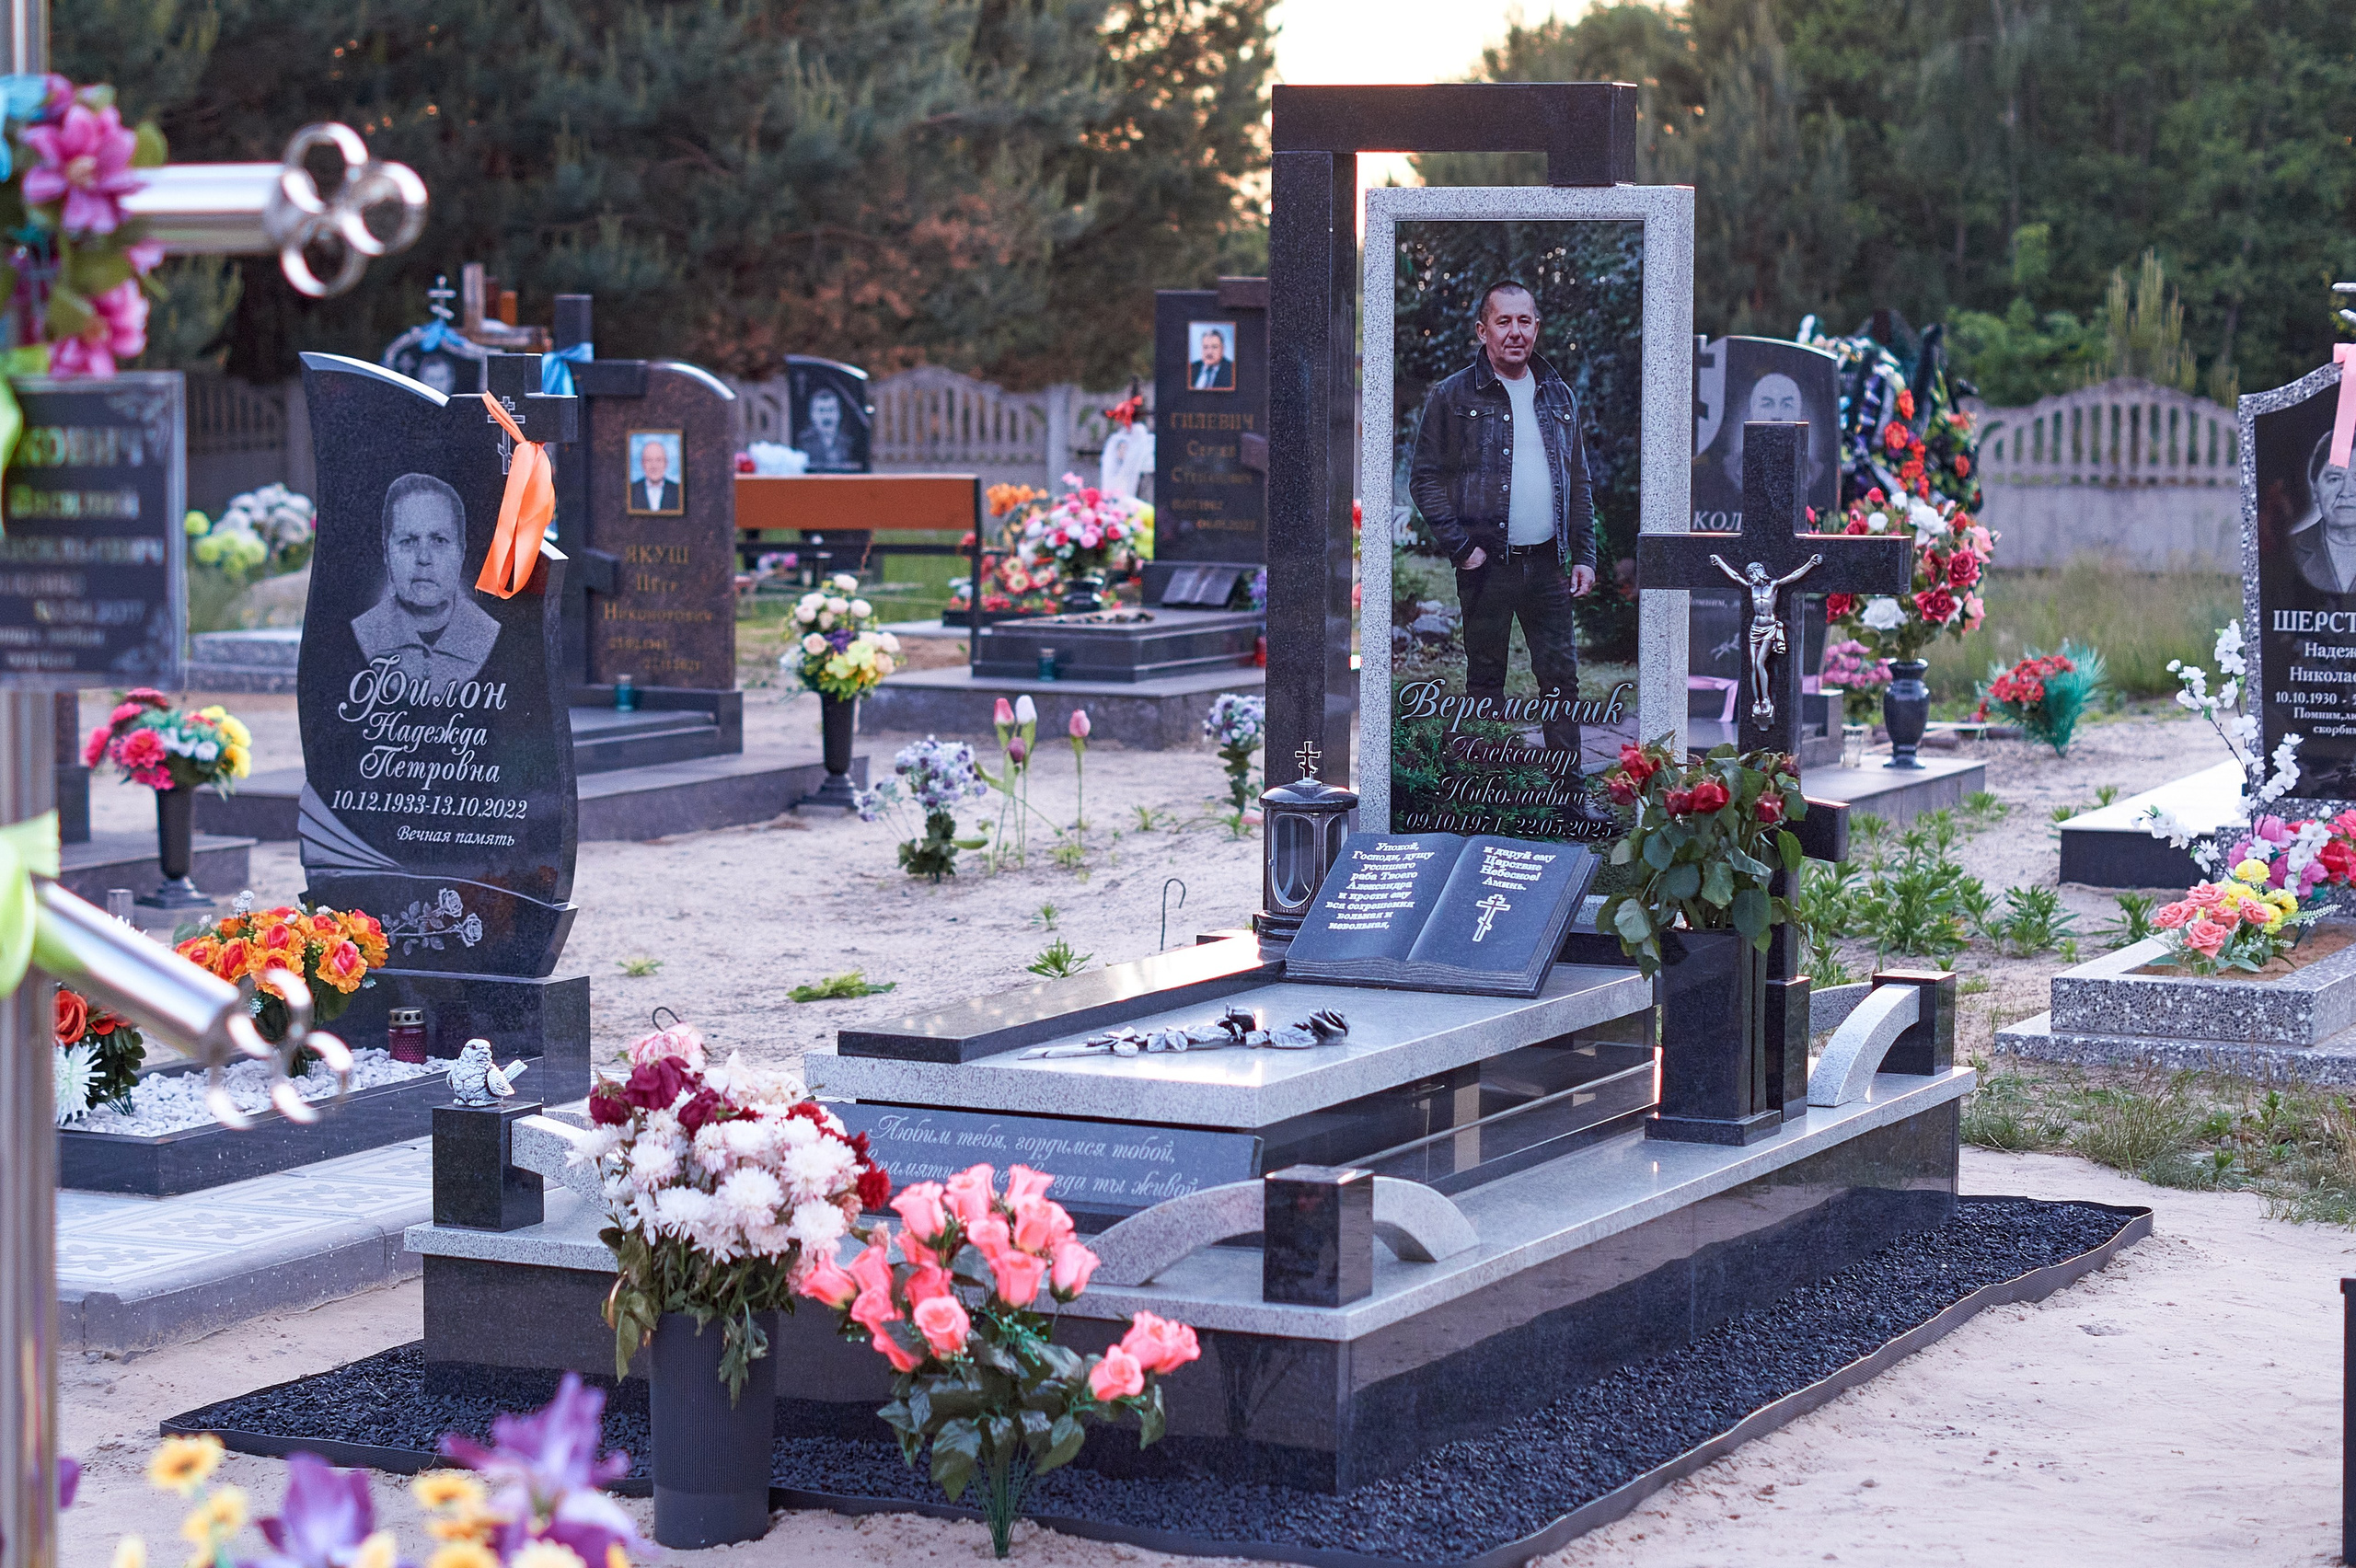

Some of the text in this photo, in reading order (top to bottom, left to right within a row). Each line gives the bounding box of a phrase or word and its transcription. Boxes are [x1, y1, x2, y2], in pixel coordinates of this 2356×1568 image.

[1170, 411, 1254, 431] ГИЛЕВИЧ
[626, 544, 689, 564] ЯКУШ
[1691, 597, 1728, 609] омним,
[339, 654, 506, 722] Филон
[1398, 678, 1633, 732] Веремейчик
[2275, 691, 2338, 705] 10.10.1930
[363, 711, 488, 755] Надежда
[1442, 735, 1578, 775] Александр
[360, 744, 500, 790] Петровна
[1436, 776, 1585, 807] Николаевич
[331, 790, 527, 819] 10.12.1933-13.10.2022
[397, 825, 515, 847] Вечная память
[1375, 842, 1420, 851] Упокой,
[1483, 846, 1556, 863] и даруй ему
[1352, 850, 1435, 861] Господи, душу
[1484, 855, 1542, 871] Царствие
[1361, 862, 1416, 871] усопшего
[1479, 865, 1542, 882] Небесное!
[1350, 871, 1418, 881] раба Твоего
[1482, 876, 1528, 891] Аминь.
[1346, 882, 1413, 891] Александра
[1348, 893, 1390, 901] прости
[1390, 891, 1413, 900] ему
[1347, 902, 1415, 912] согрешения
[868, 1114, 1176, 1164] Любим тебя, гордимся тобой,
[1092, 1176, 1126, 1194] ты
